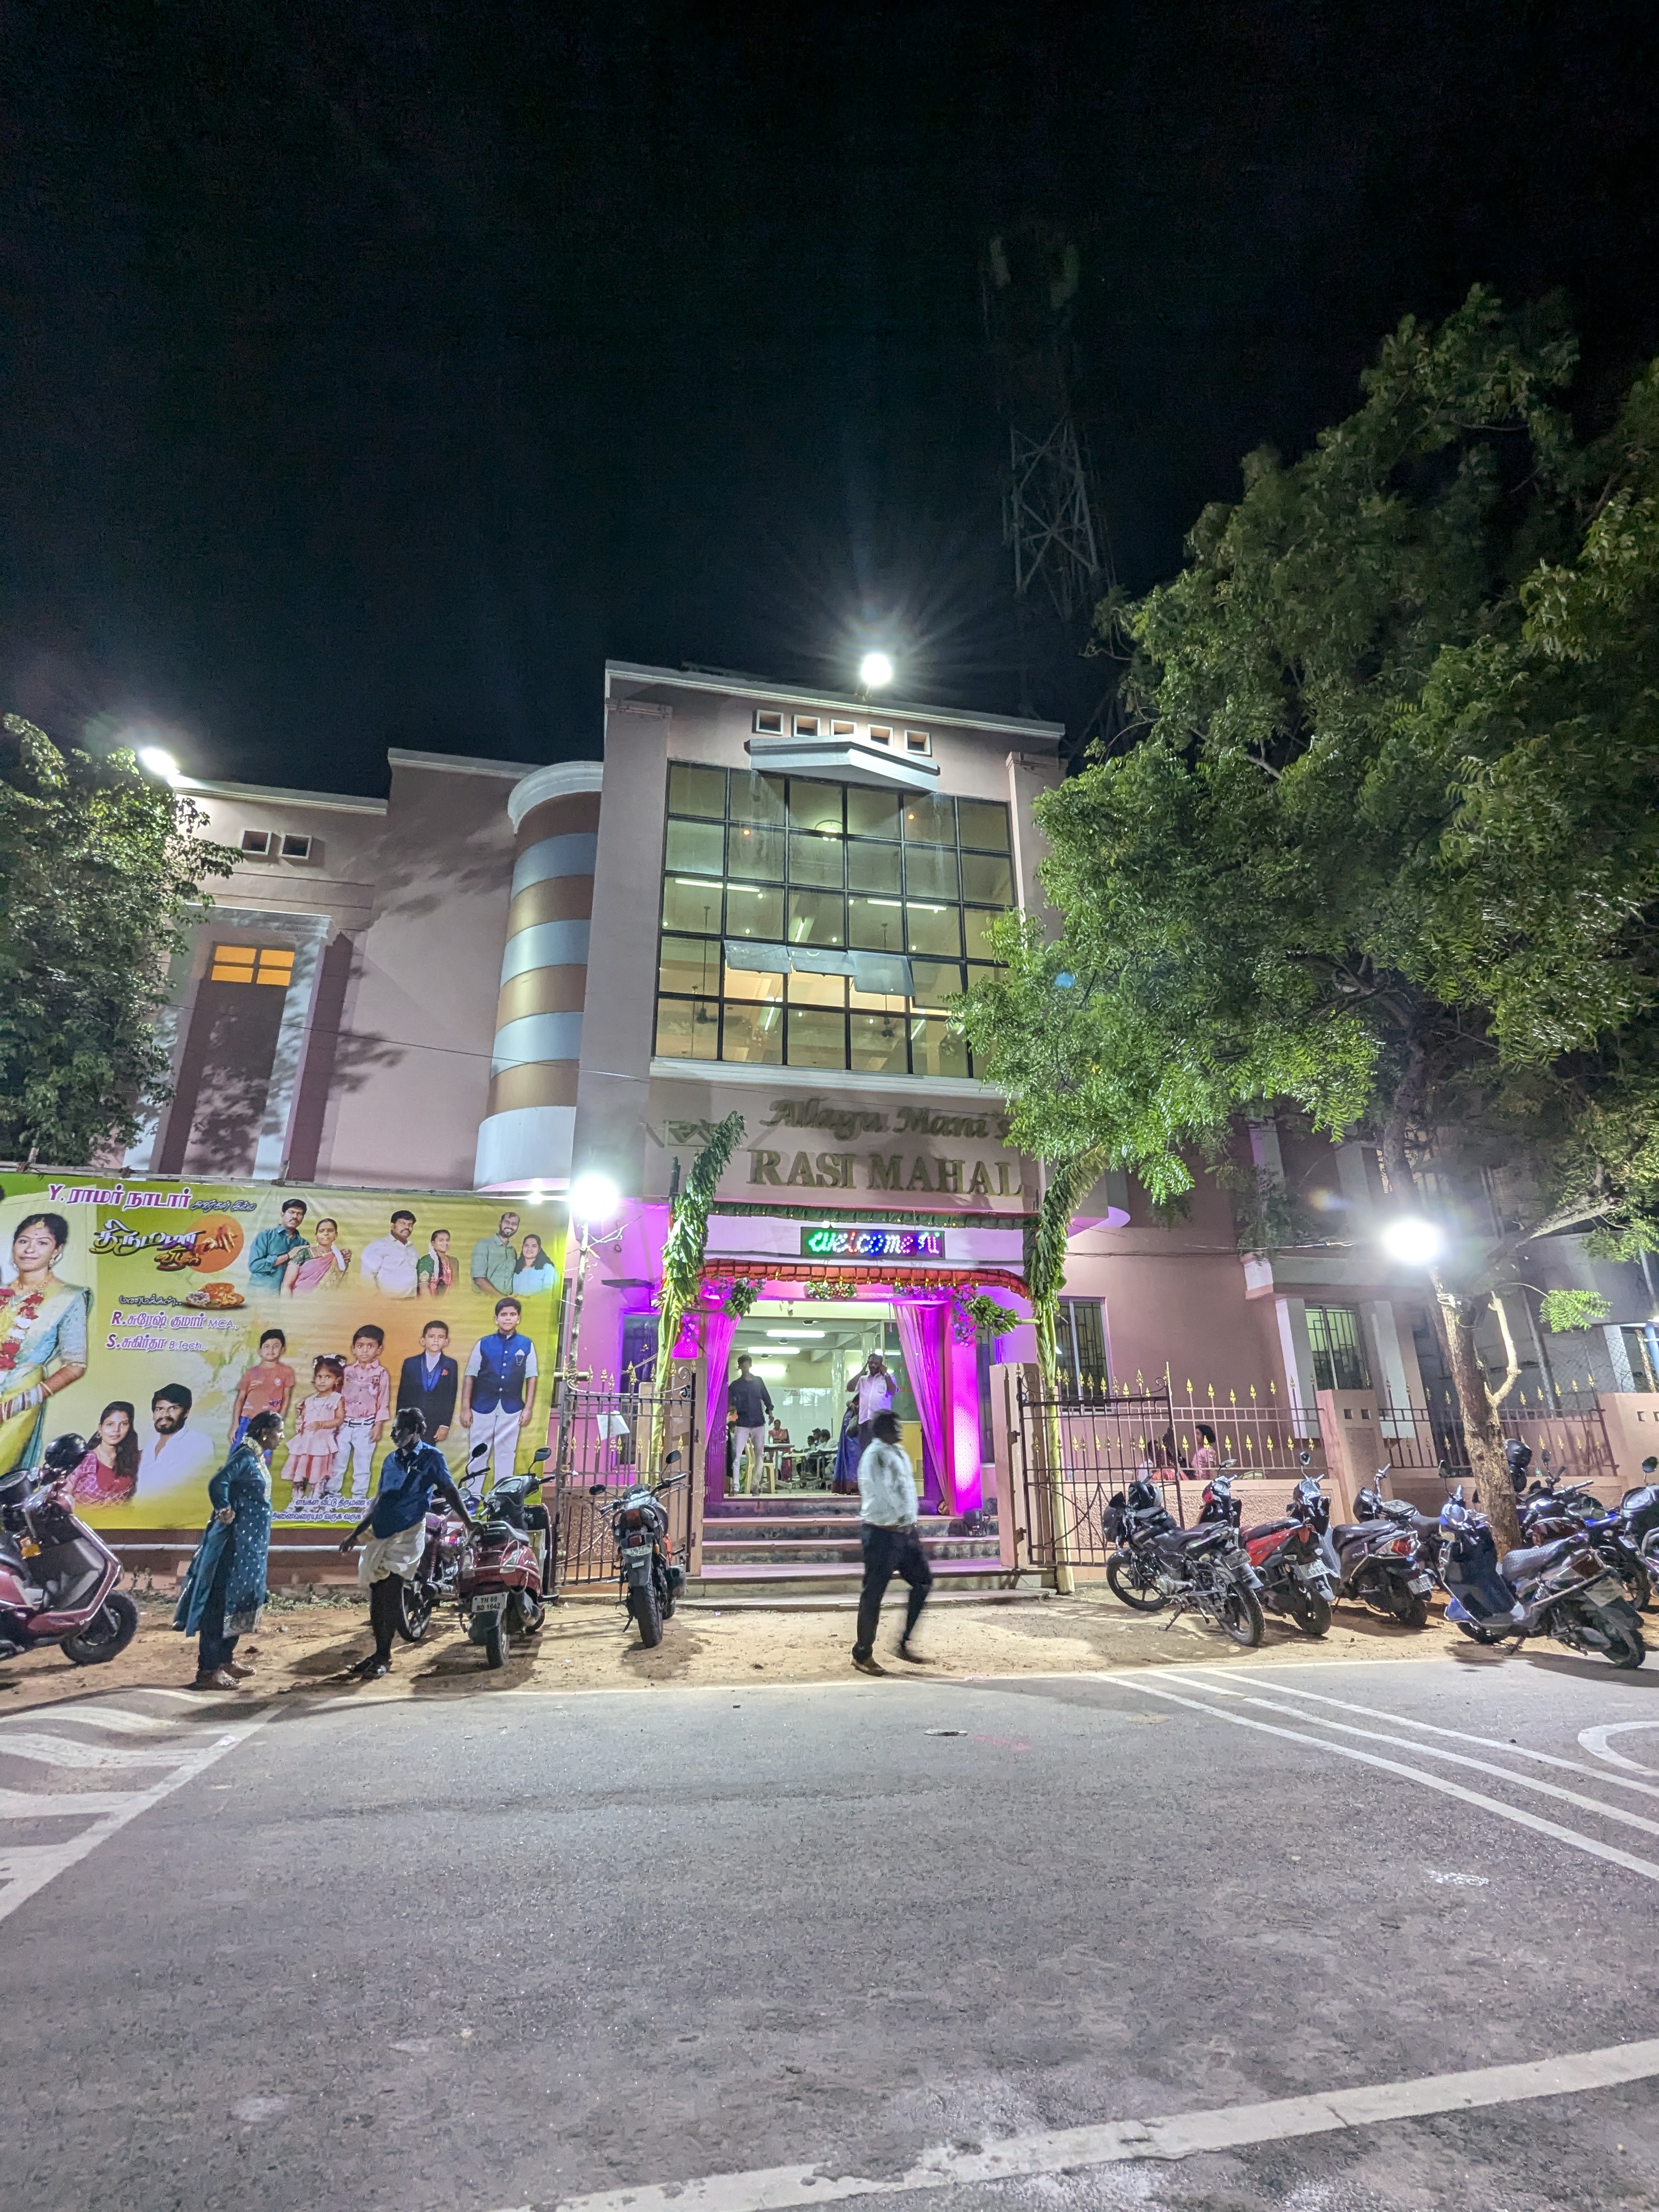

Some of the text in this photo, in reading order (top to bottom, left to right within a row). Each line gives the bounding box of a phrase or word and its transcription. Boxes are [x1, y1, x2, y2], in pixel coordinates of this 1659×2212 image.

[747, 1150, 1024, 1197] RASI MAHAL
[122, 1187, 191, 1211] நாடார்
[89, 1219, 206, 1256] திருமண
[171, 1313, 206, 1329] குமார்
[338, 1498, 365, 1508] திருமண
[324, 1513, 342, 1522] வருக
